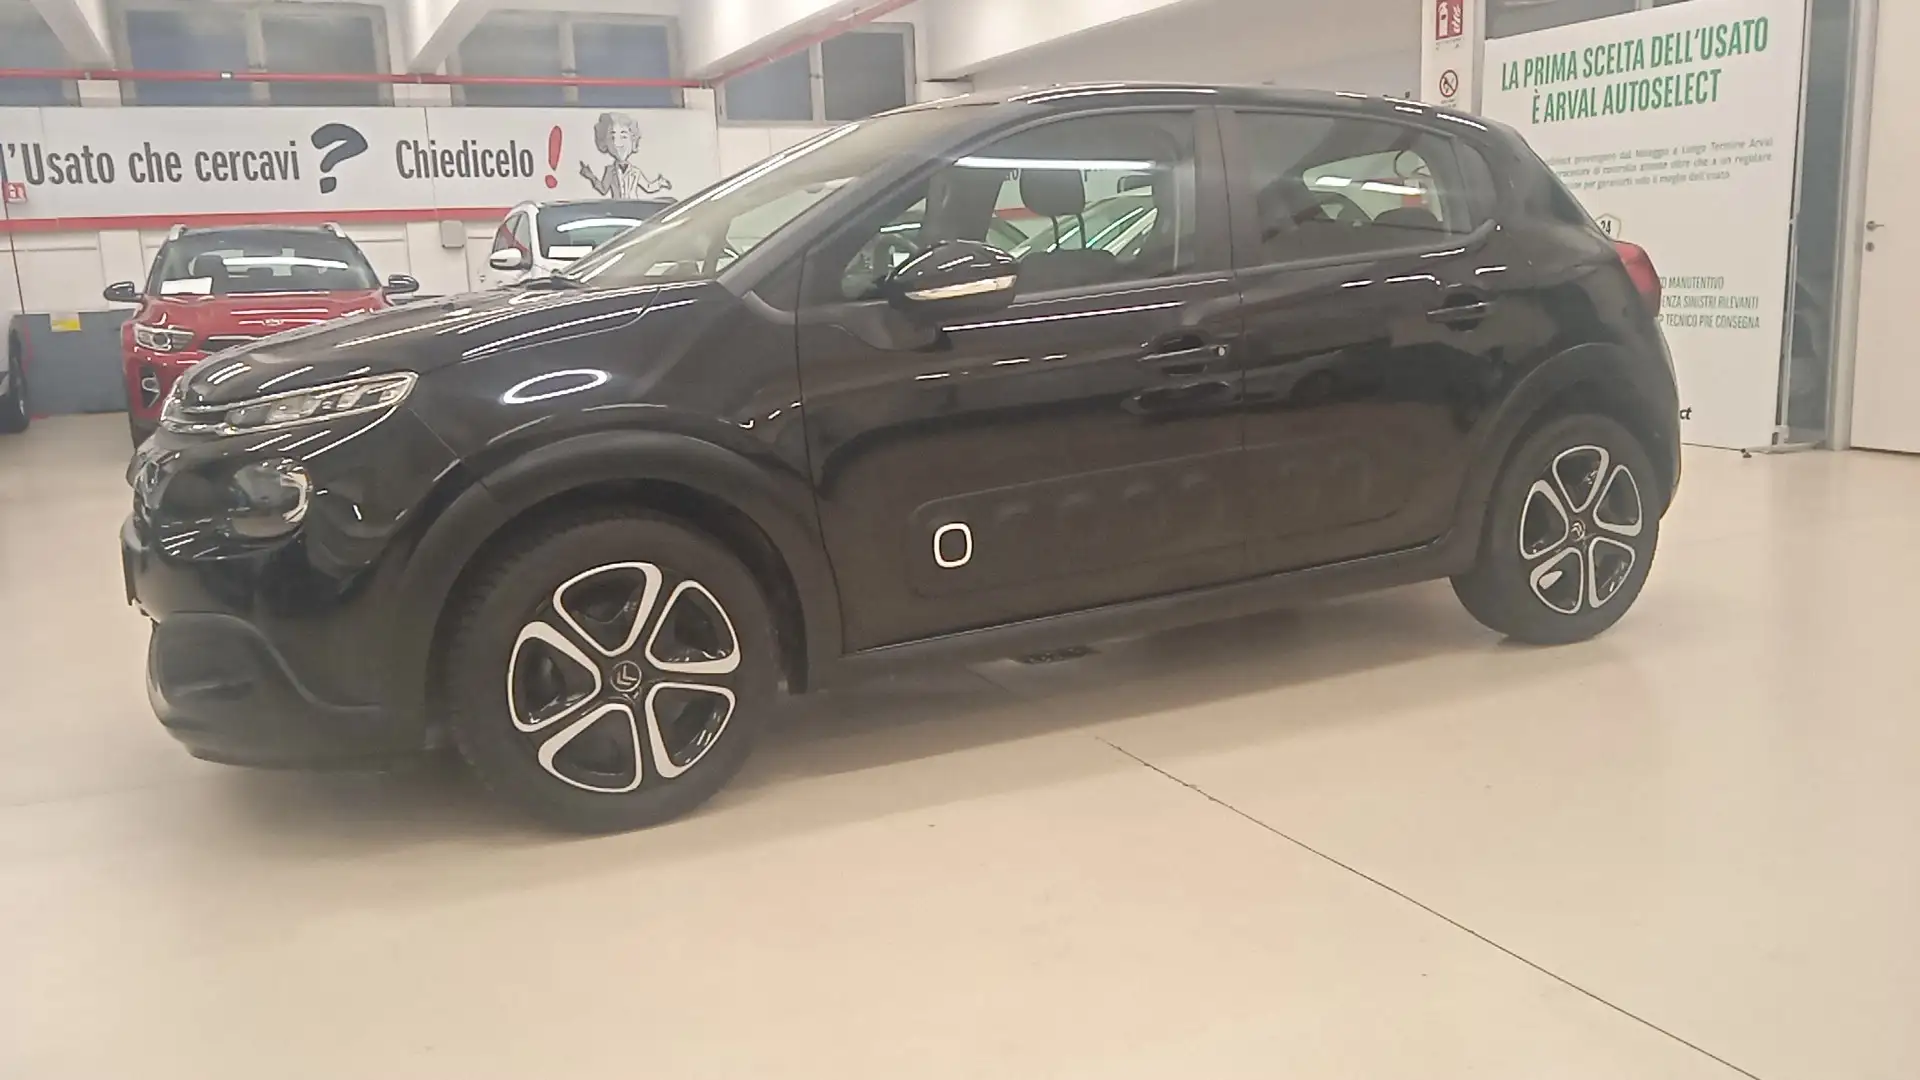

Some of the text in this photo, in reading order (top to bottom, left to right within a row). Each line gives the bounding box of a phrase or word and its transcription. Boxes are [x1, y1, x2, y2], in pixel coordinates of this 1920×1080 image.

[1501, 16, 1769, 91] LA PRIMA SCELTA DELL'USATO
[1531, 68, 1722, 124] È ARVAL AUTOSELECT
[128, 142, 182, 183] che
[195, 140, 300, 182] cercavi
[396, 140, 534, 179] Chiedicelo
[1669, 275, 1725, 290] MANUTENTIVO
[1718, 295, 1759, 310] RILEVANTI
[1666, 313, 1698, 327] TECNICO
[1699, 314, 1713, 328] PRE
[1715, 315, 1760, 329] CONSEGNA
